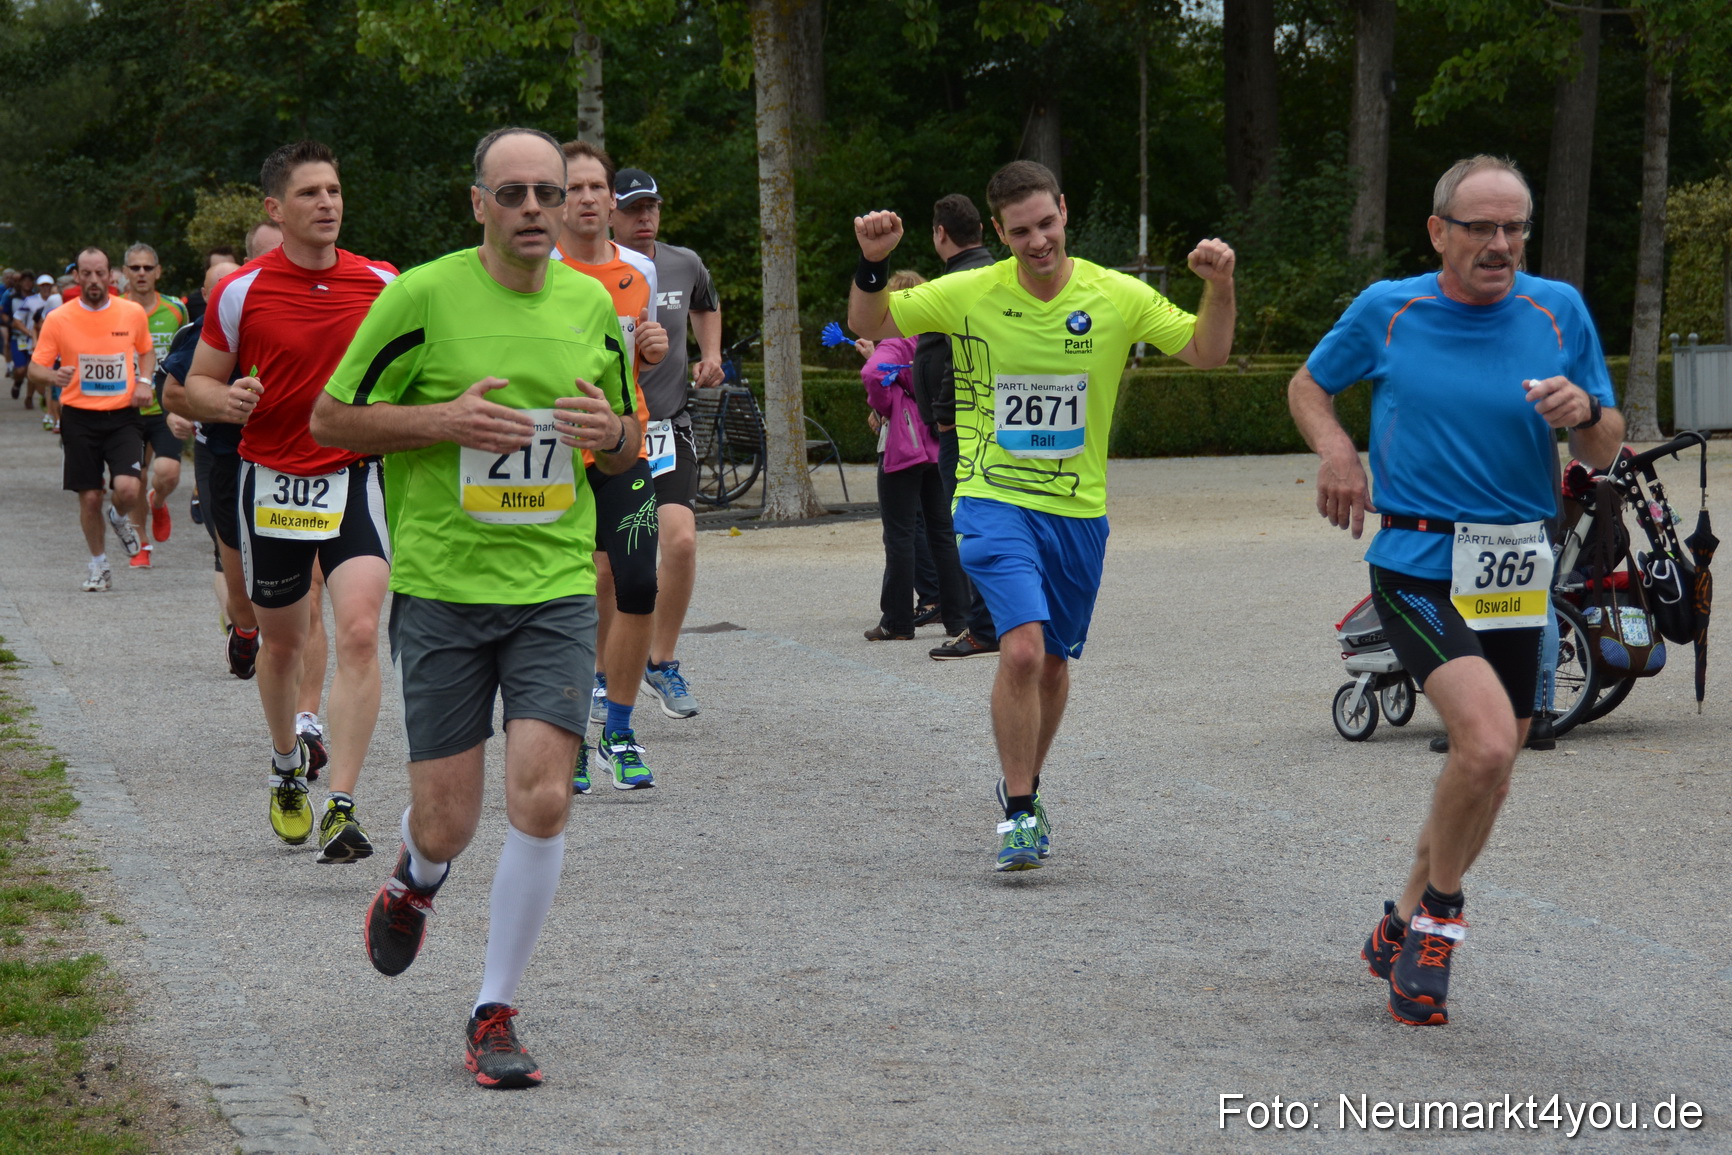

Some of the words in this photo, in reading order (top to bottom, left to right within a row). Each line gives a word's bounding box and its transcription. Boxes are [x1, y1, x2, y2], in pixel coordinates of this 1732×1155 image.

[1065, 339, 1093, 348] Partl
[84, 364, 123, 380] 2087
[997, 383, 1028, 391] PARTL
[1031, 383, 1074, 392] Neumarkt
[1005, 395, 1078, 426] 2671
[533, 422, 556, 432] mark
[644, 434, 666, 457] 07
[1031, 434, 1056, 447] Ralf
[488, 438, 557, 480] 217
[273, 474, 330, 508] 302
[501, 491, 545, 508] Alfred
[269, 512, 330, 529] Alexander
[1457, 534, 1494, 546] PARTL
[1496, 533, 1537, 547] Neumarkt
[1475, 550, 1537, 589] 365
[1475, 596, 1521, 615] Oswald
